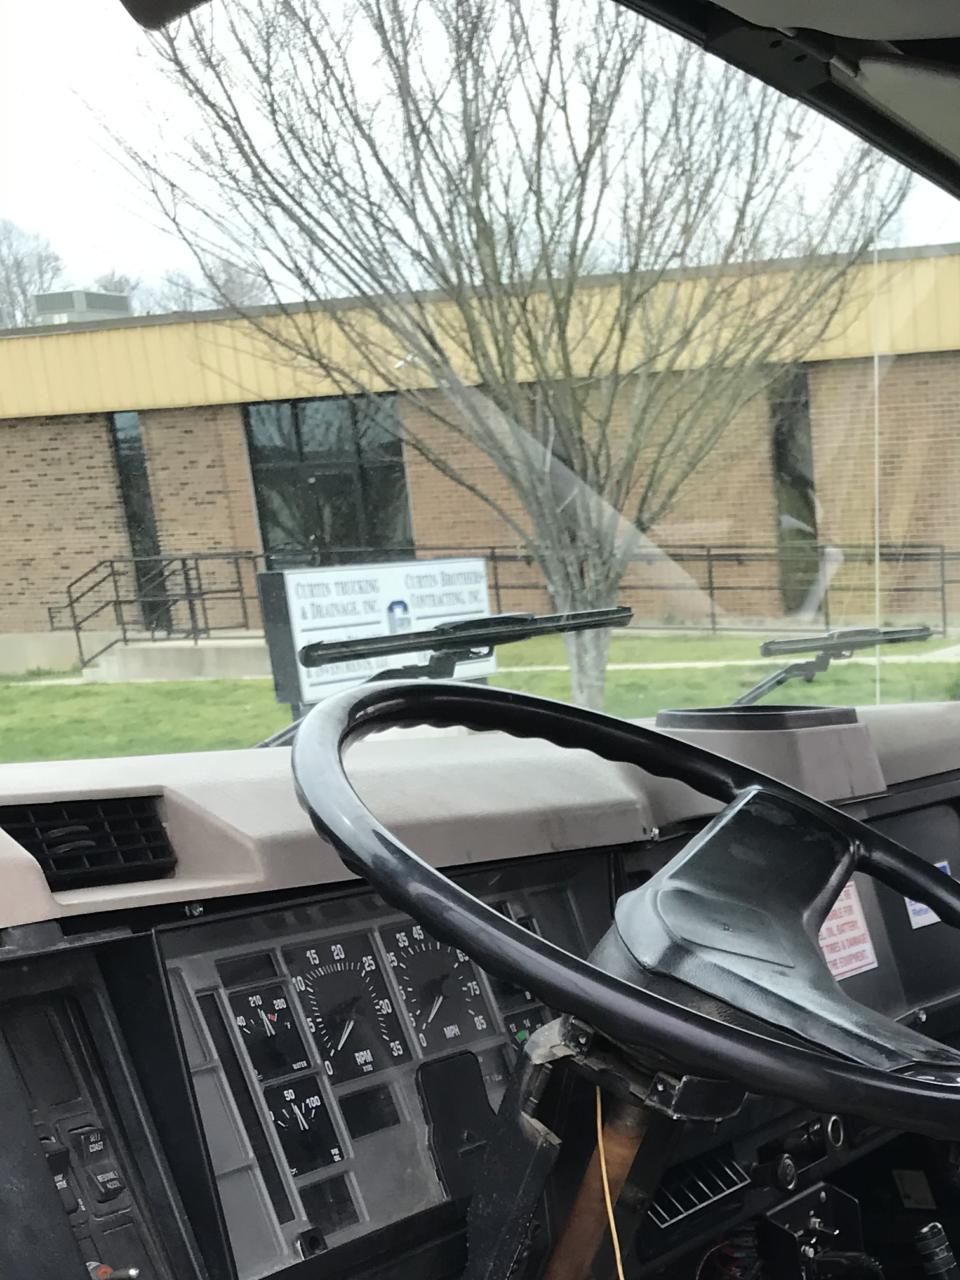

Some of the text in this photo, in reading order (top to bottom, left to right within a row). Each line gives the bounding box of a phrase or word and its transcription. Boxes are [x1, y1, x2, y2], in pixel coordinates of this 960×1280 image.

[396, 932, 409, 948] 35
[412, 925, 424, 940] 45
[306, 949, 320, 966] 15
[331, 944, 346, 961] 20
[362, 955, 376, 972] 25
[291, 975, 306, 993] 10
[467, 981, 480, 997] 75
[248, 994, 263, 1008] 210
[379, 998, 393, 1015] 30
[306, 1017, 316, 1034] 5
[473, 1015, 487, 1031] 85
[442, 1023, 461, 1040] MPH
[418, 1032, 428, 1048] 0
[388, 1040, 404, 1057] 35
[353, 1049, 374, 1066] RPM
[324, 1060, 334, 1076] 0
[283, 1088, 296, 1101] 50
[305, 1095, 322, 1109] 100
